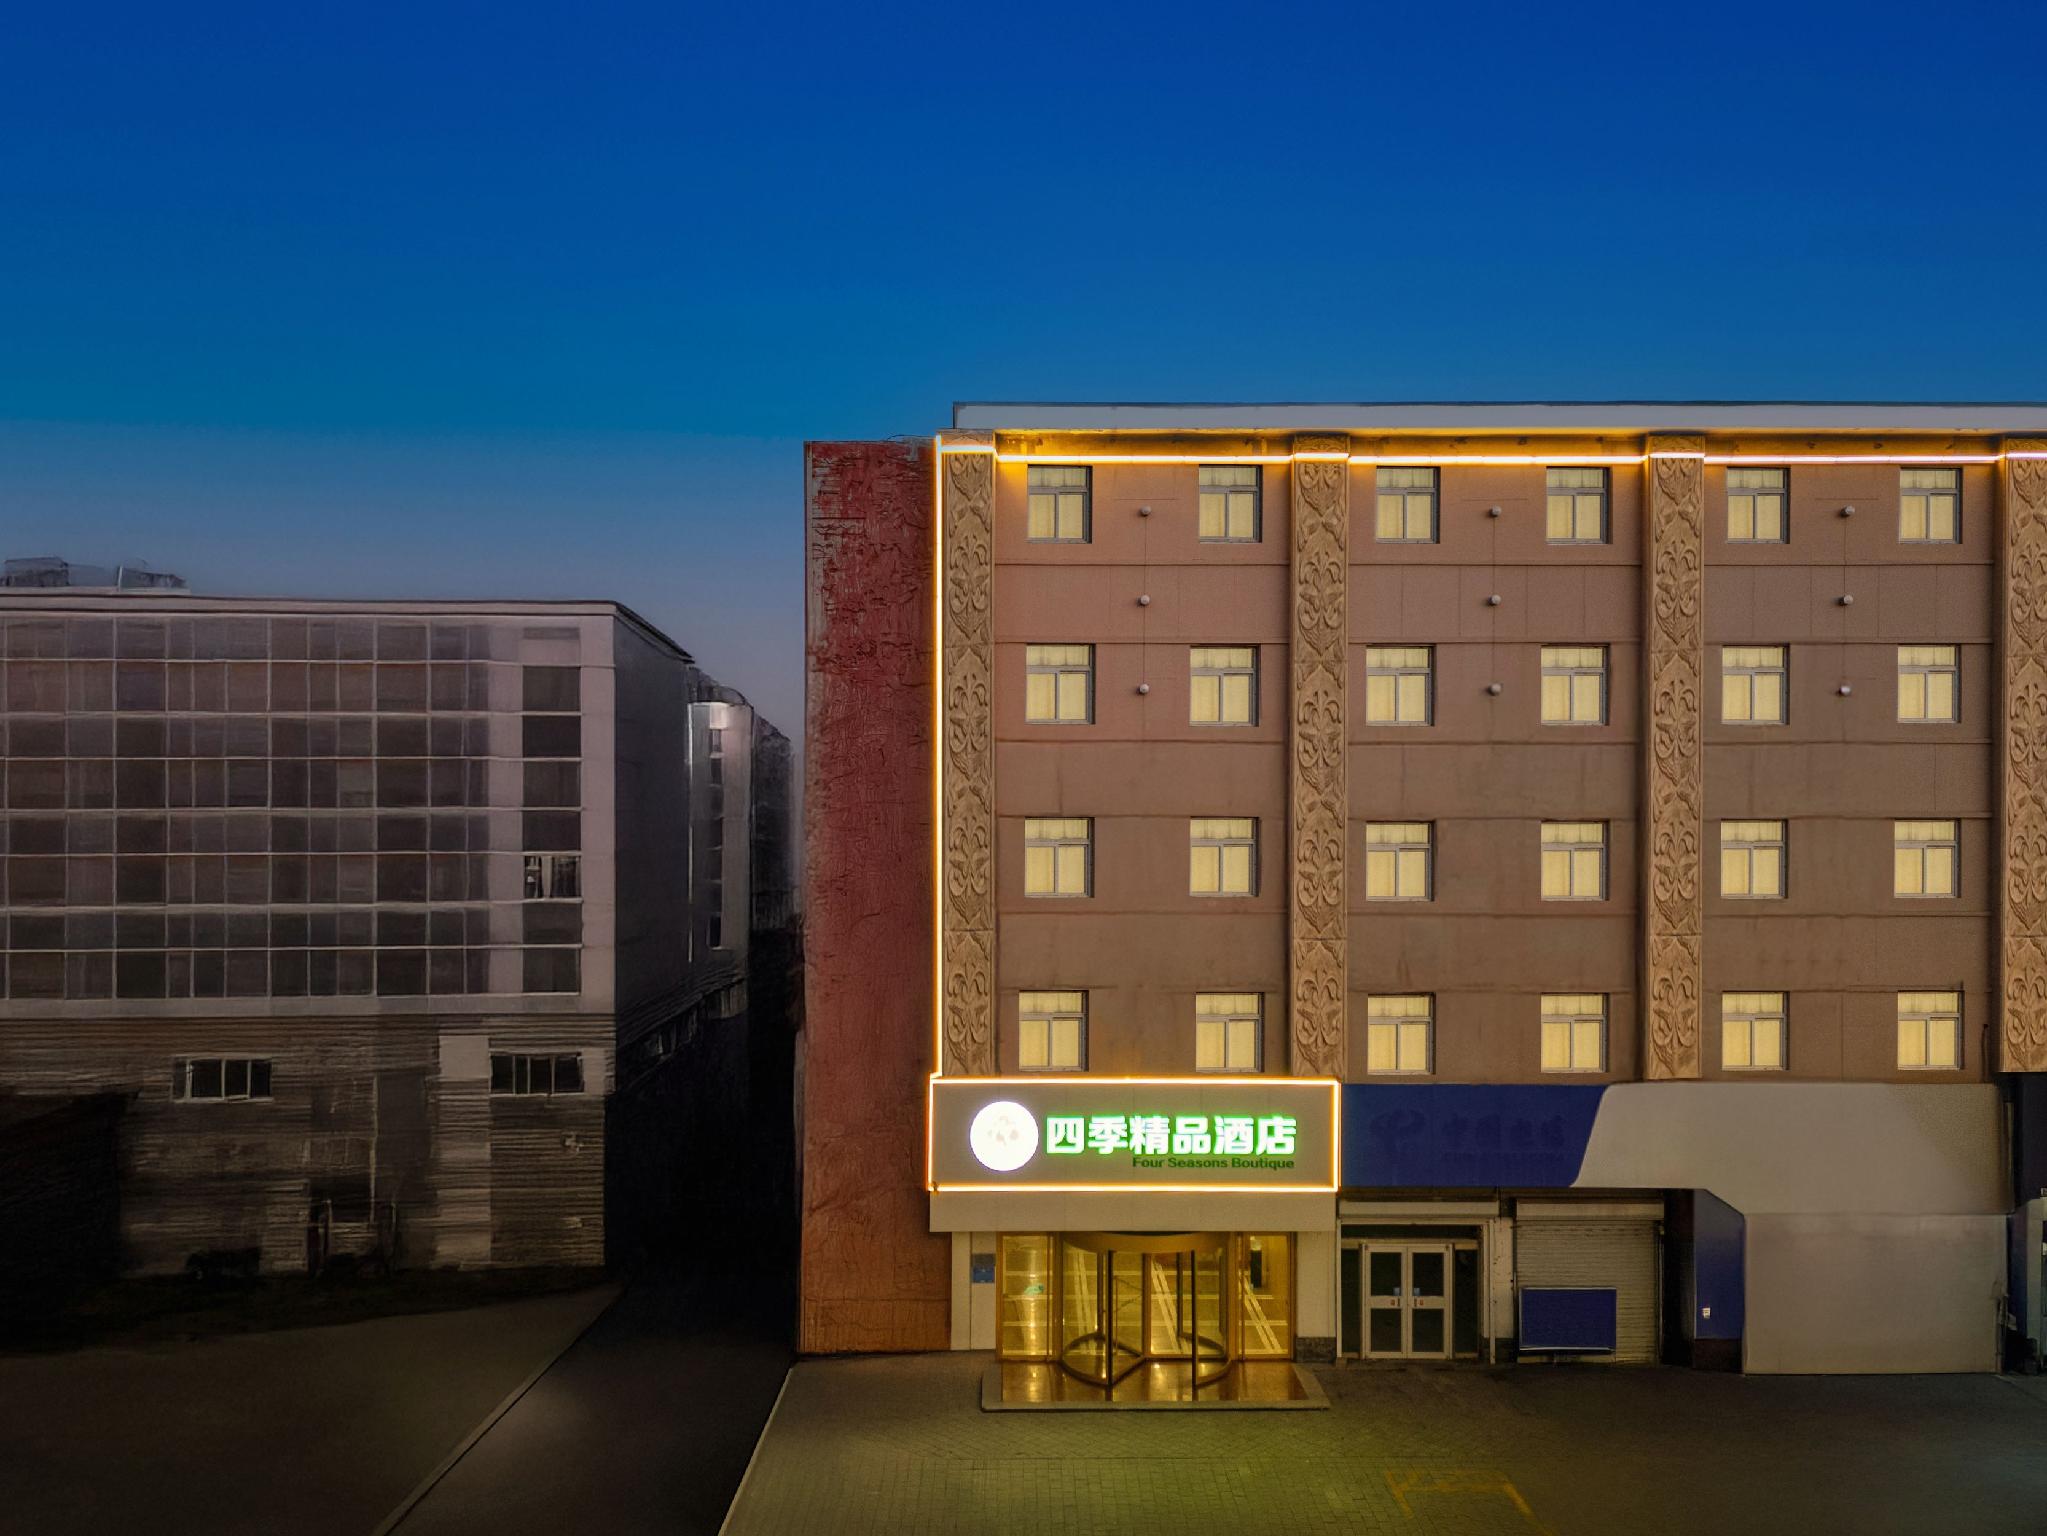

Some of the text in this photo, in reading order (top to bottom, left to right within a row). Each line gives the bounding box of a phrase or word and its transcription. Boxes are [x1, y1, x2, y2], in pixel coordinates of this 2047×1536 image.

[1046, 1115, 1296, 1155] 四季精品酒店
[1132, 1157, 1295, 1171] Four Seasons Boutique
